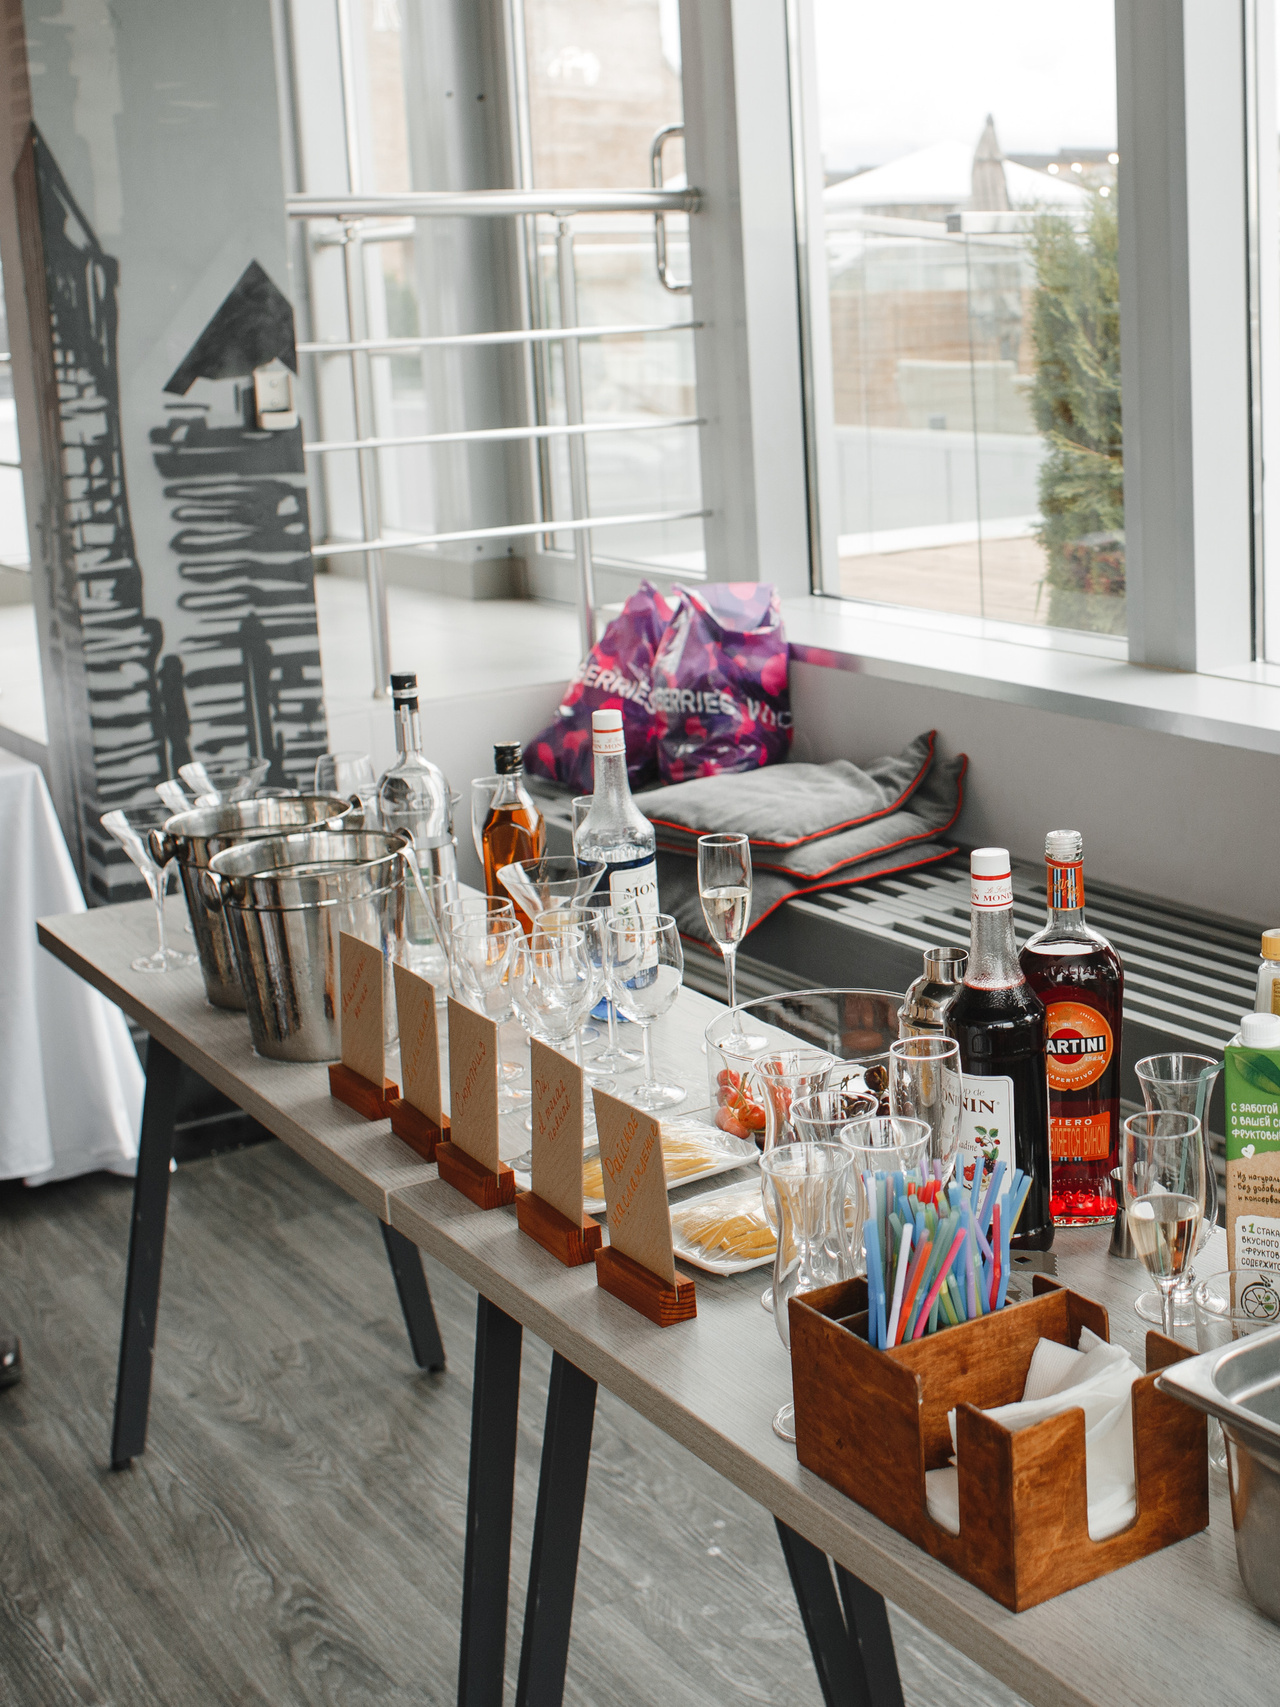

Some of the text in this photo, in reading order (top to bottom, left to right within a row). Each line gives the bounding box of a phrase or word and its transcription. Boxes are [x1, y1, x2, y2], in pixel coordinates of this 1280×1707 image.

[1046, 1036, 1104, 1054] ARTINI
[455, 1041, 486, 1117] Сюрприз
[1049, 1069, 1093, 1083] 'APERITIVO
[962, 1097, 996, 1114] NIN
[1231, 1102, 1279, 1115] С ЗАБОТОЙ
[1050, 1118, 1093, 1126] FIERO
[1231, 1116, 1238, 1126] О
[1239, 1115, 1271, 1127] ВАШЕЙ
[1051, 1124, 1109, 1156] ВЛЯЕТСЯ ВИНОМ
[603, 1111, 639, 1185] Райское
[1237, 1171, 1246, 1183] Из
[1237, 1182, 1251, 1194] Без
[1248, 1222, 1256, 1234] 1
[1241, 1235, 1280, 1249] ВКУСНОГО
